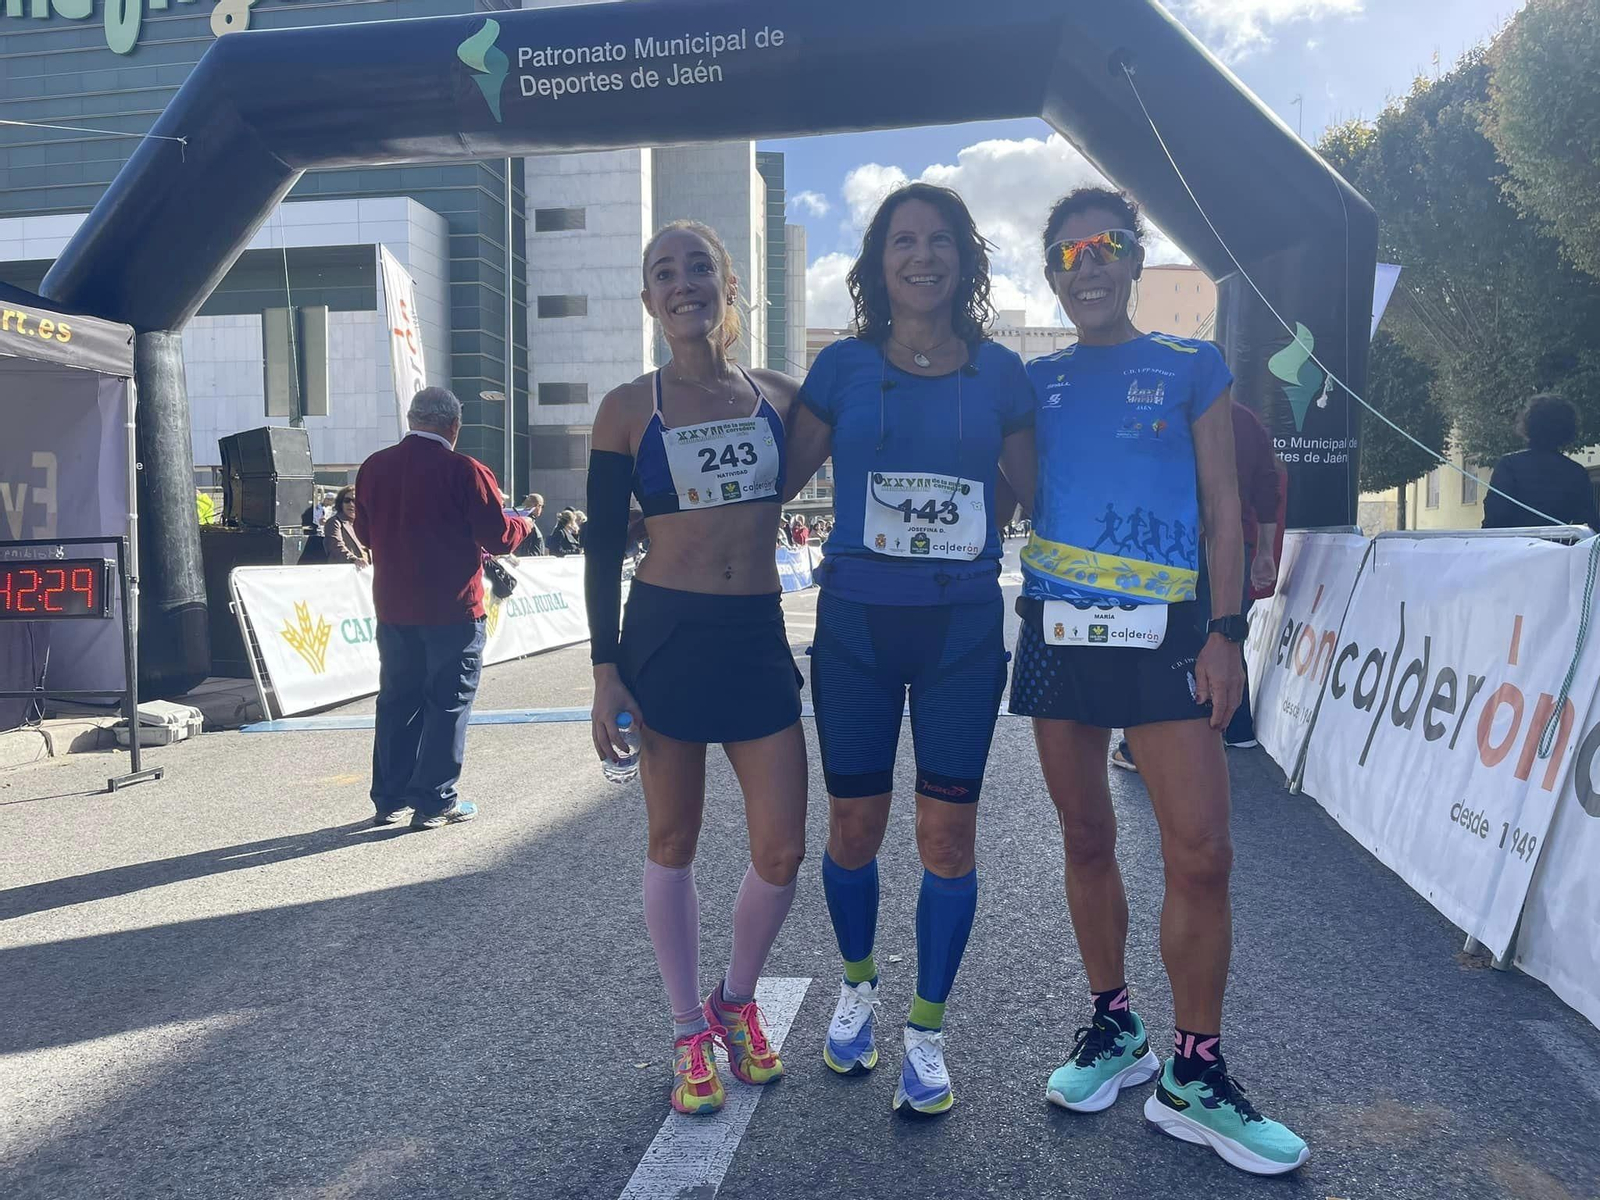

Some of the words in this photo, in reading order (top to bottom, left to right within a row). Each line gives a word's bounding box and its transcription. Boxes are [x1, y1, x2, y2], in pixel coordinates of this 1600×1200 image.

[518, 41, 627, 68] Patronato
[634, 28, 746, 59] Municipal
[754, 26, 785, 49] de
[520, 70, 624, 100] Deportes
[631, 66, 659, 89] de
[667, 60, 723, 86] Jaén
[2, 309, 72, 343] rt.es
[698, 442, 758, 473] 243
[1290, 437, 1347, 451] Municipal
[1348, 437, 1358, 448] de
[1304, 452, 1320, 462] de
[1323, 452, 1348, 464] Jaén
[717, 469, 748, 479] NATIVIDAD
[898, 498, 960, 525] 143
[932, 541, 979, 555] calderón
[532, 591, 569, 614] RURAL
[340, 616, 376, 644] CAJ
[1111, 627, 1159, 642] calderón
[1331, 601, 1576, 792] calderón
[1450, 798, 1490, 840] desde
[1499, 821, 1538, 864] 1949
